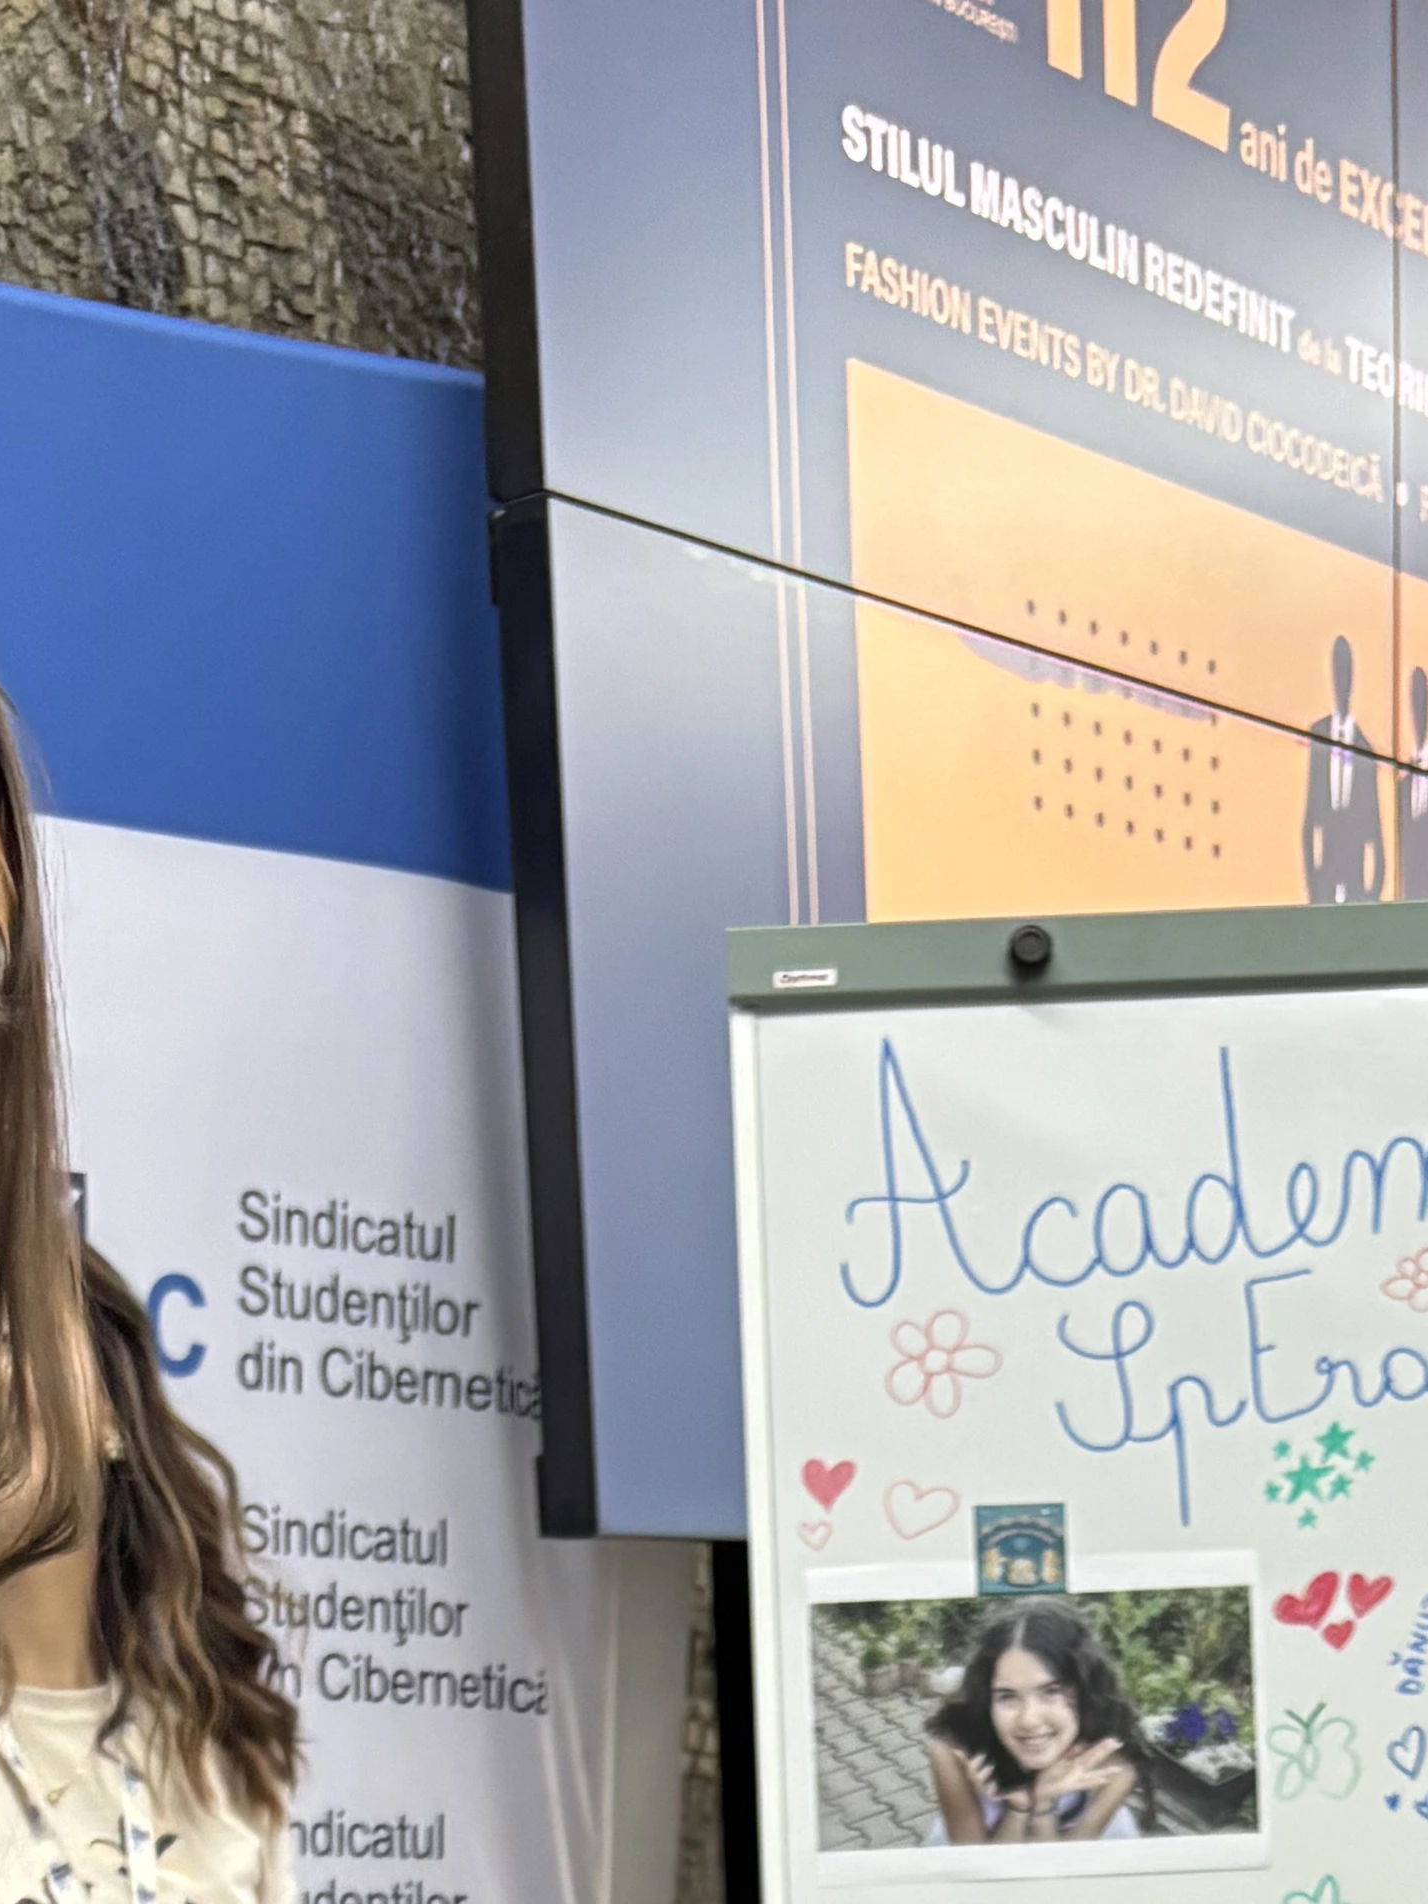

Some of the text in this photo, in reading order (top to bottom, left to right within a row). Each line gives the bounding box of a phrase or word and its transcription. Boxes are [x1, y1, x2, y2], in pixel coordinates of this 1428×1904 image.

[1239, 122, 1288, 183] ani
[1294, 137, 1332, 203] de
[842, 104, 965, 208] STILUL
[970, 160, 1139, 285] MASCULIN
[1144, 240, 1296, 353] REDEFINIT
[844, 241, 973, 335] FASHION
[977, 297, 1081, 379] EVENTS
[1086, 341, 1121, 395] BY
[1124, 357, 1166, 413] DR.
[1170, 378, 1242, 445] DAVID
[238, 1190, 455, 1263] Sindicatul
[238, 1339, 303, 1395] din
[241, 1505, 448, 1566] Sindicatul
